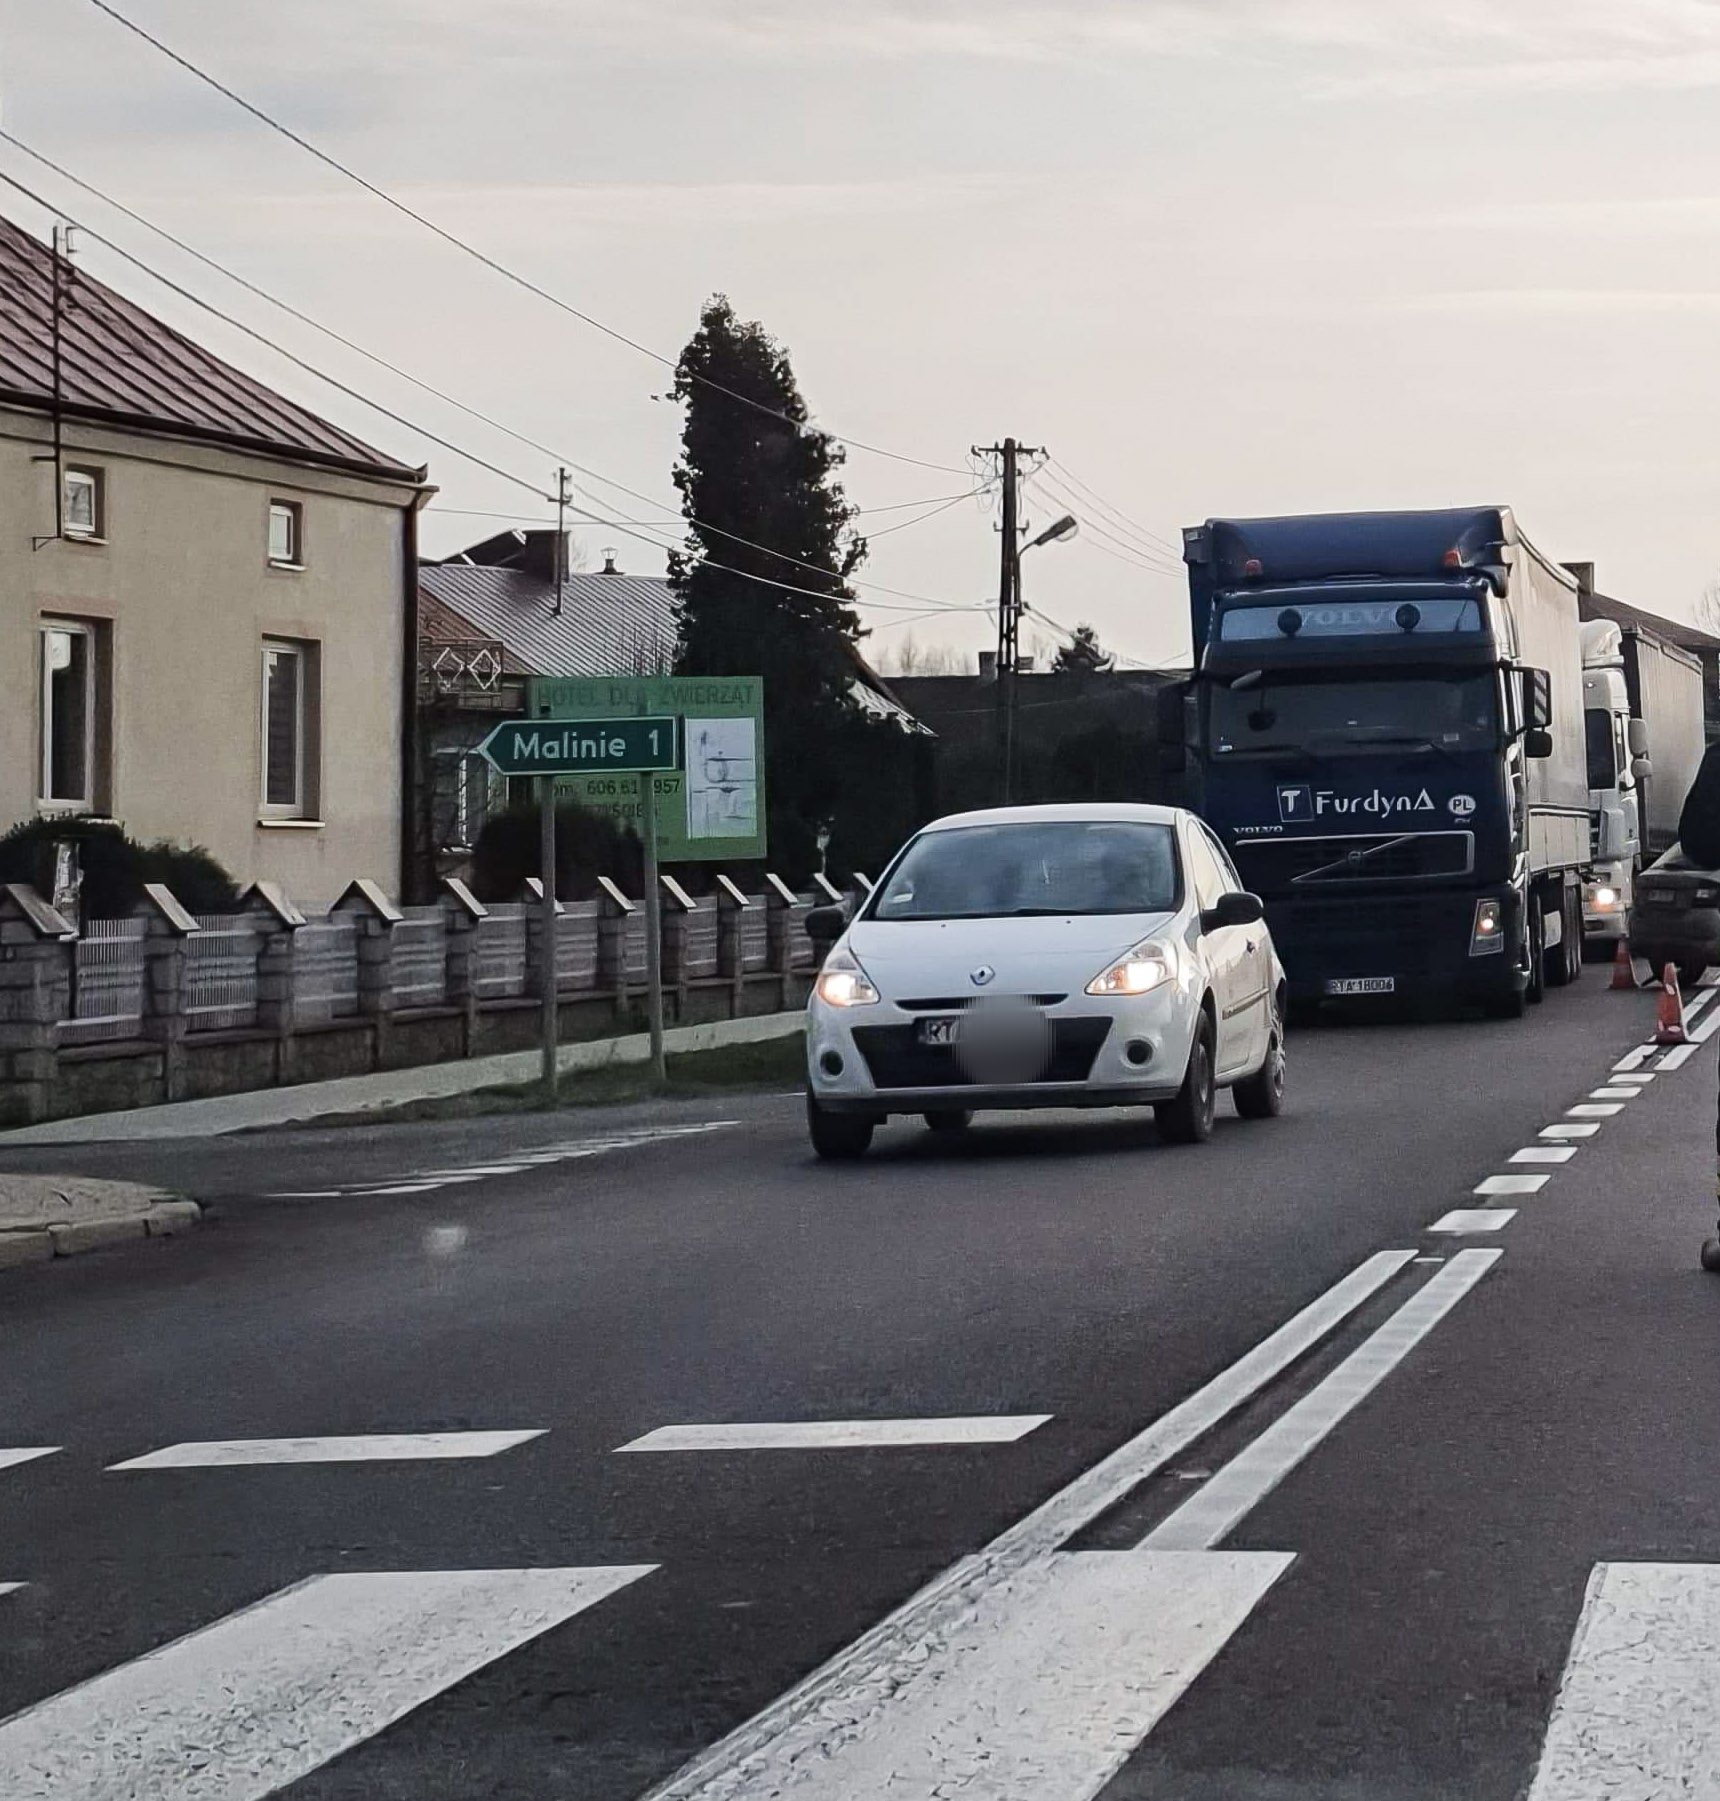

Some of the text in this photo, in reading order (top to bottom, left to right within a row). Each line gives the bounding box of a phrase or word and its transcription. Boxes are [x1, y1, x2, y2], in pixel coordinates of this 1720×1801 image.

[513, 728, 659, 760] Malinie 1
[1453, 796, 1474, 812] PL
[1233, 825, 1284, 835] VOLVO
